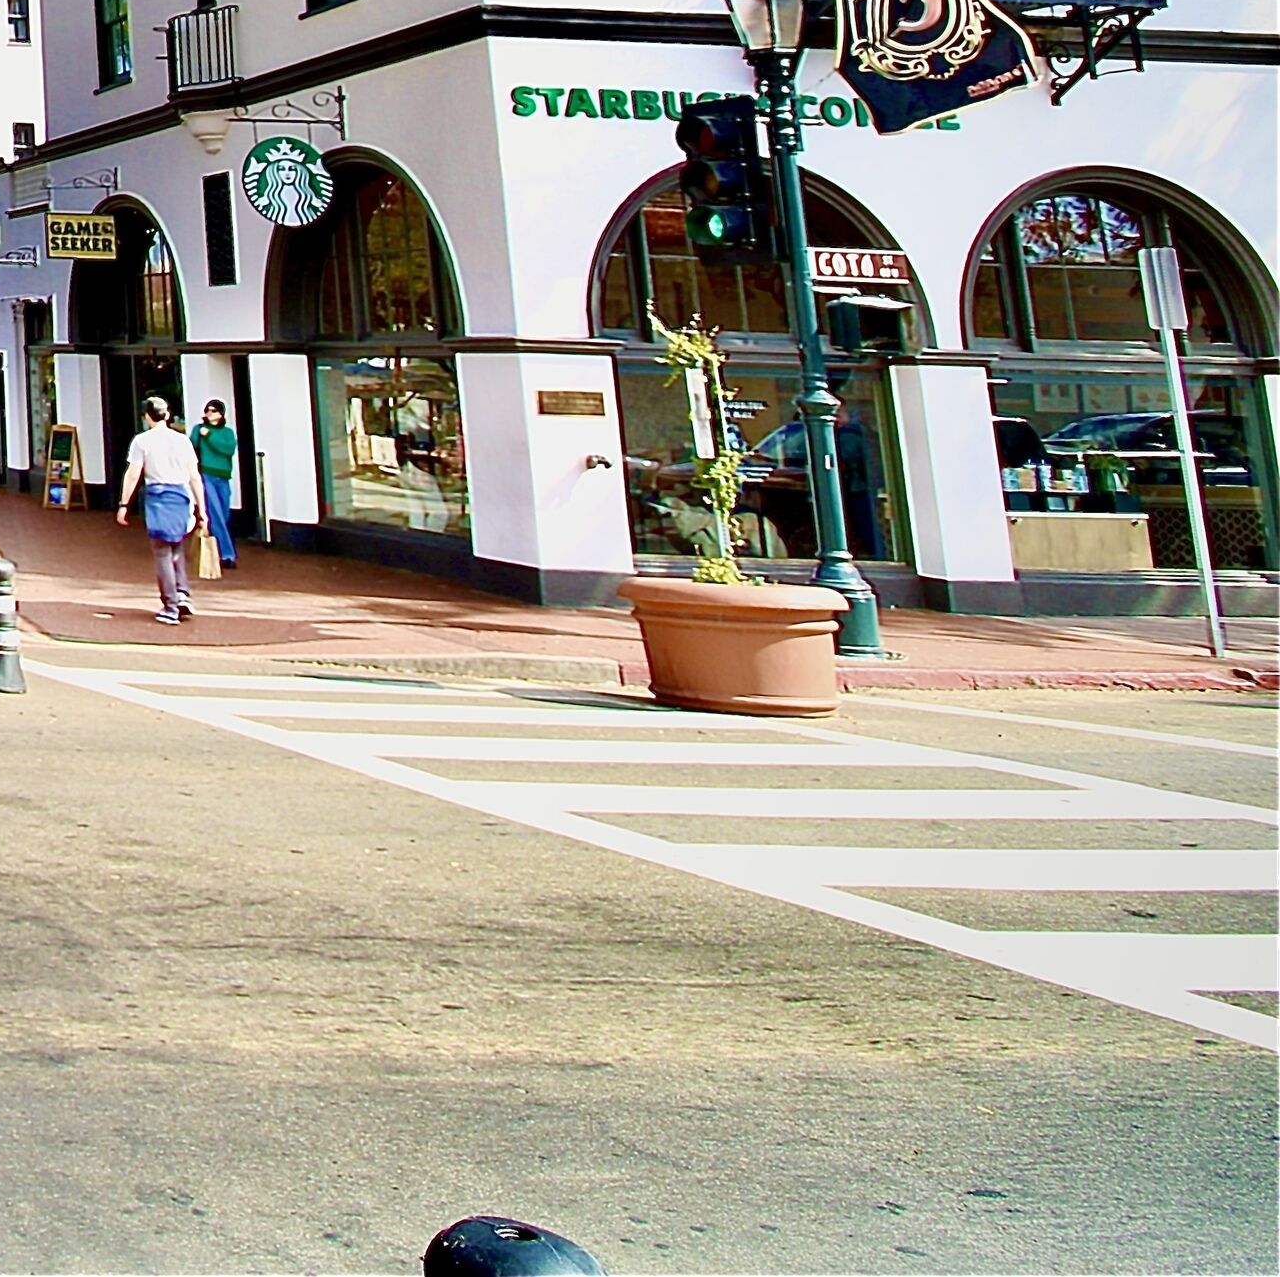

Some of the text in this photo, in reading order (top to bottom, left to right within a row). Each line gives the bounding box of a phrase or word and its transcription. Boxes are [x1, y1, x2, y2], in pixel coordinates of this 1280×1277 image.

[510, 85, 771, 123] STARBU
[49, 220, 102, 236] GAME
[50, 236, 113, 252] SEEKER
[818, 252, 875, 278] COTA
